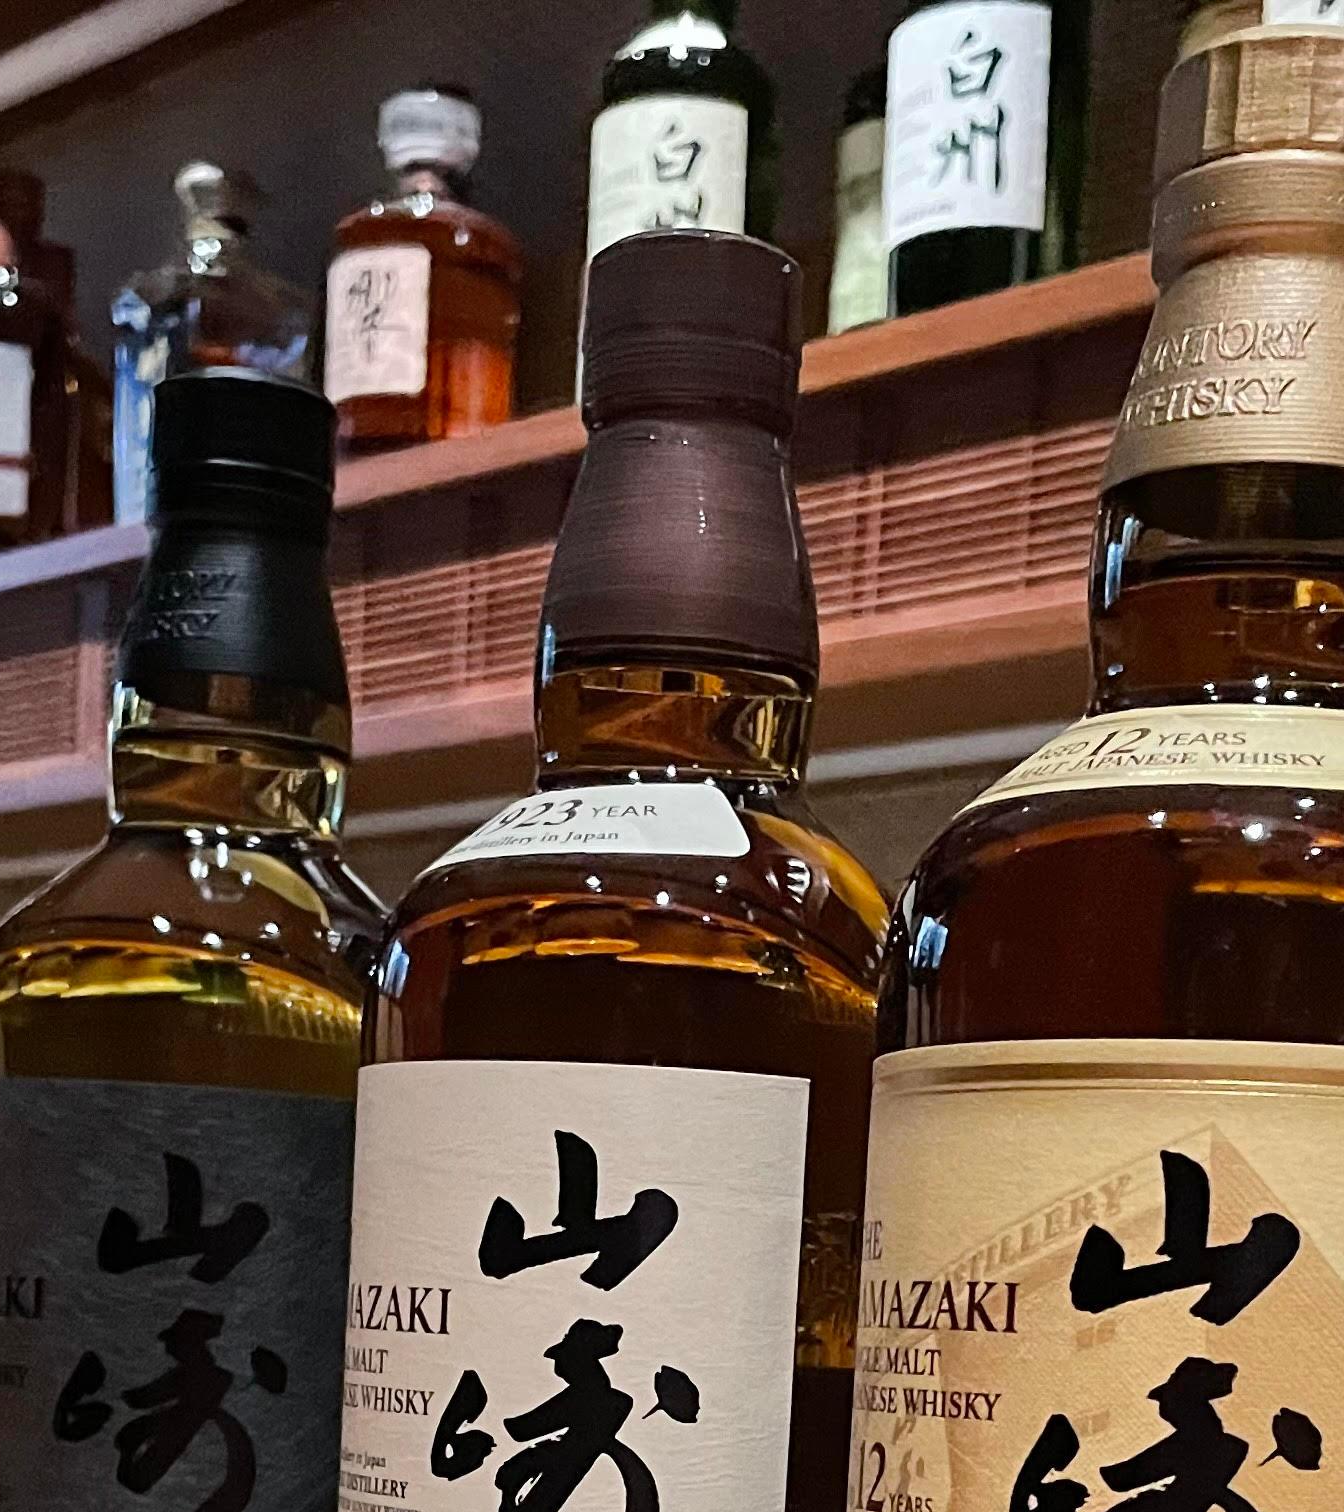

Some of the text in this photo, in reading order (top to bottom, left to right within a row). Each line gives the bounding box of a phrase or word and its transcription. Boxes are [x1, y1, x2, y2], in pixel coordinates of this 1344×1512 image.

[1088, 727, 1152, 757] 12
[1157, 732, 1247, 747] YEARS
[1066, 751, 1199, 773] JAPANESE
[1211, 751, 1327, 768] WHISKY
[592, 804, 658, 818] YEAR
[564, 831, 619, 844] Japan
[886, 1347, 942, 1376] MALT
[361, 1384, 435, 1416] WHISKY
[903, 1387, 1002, 1422] WHISKY
[855, 1439, 887, 1512] 12
